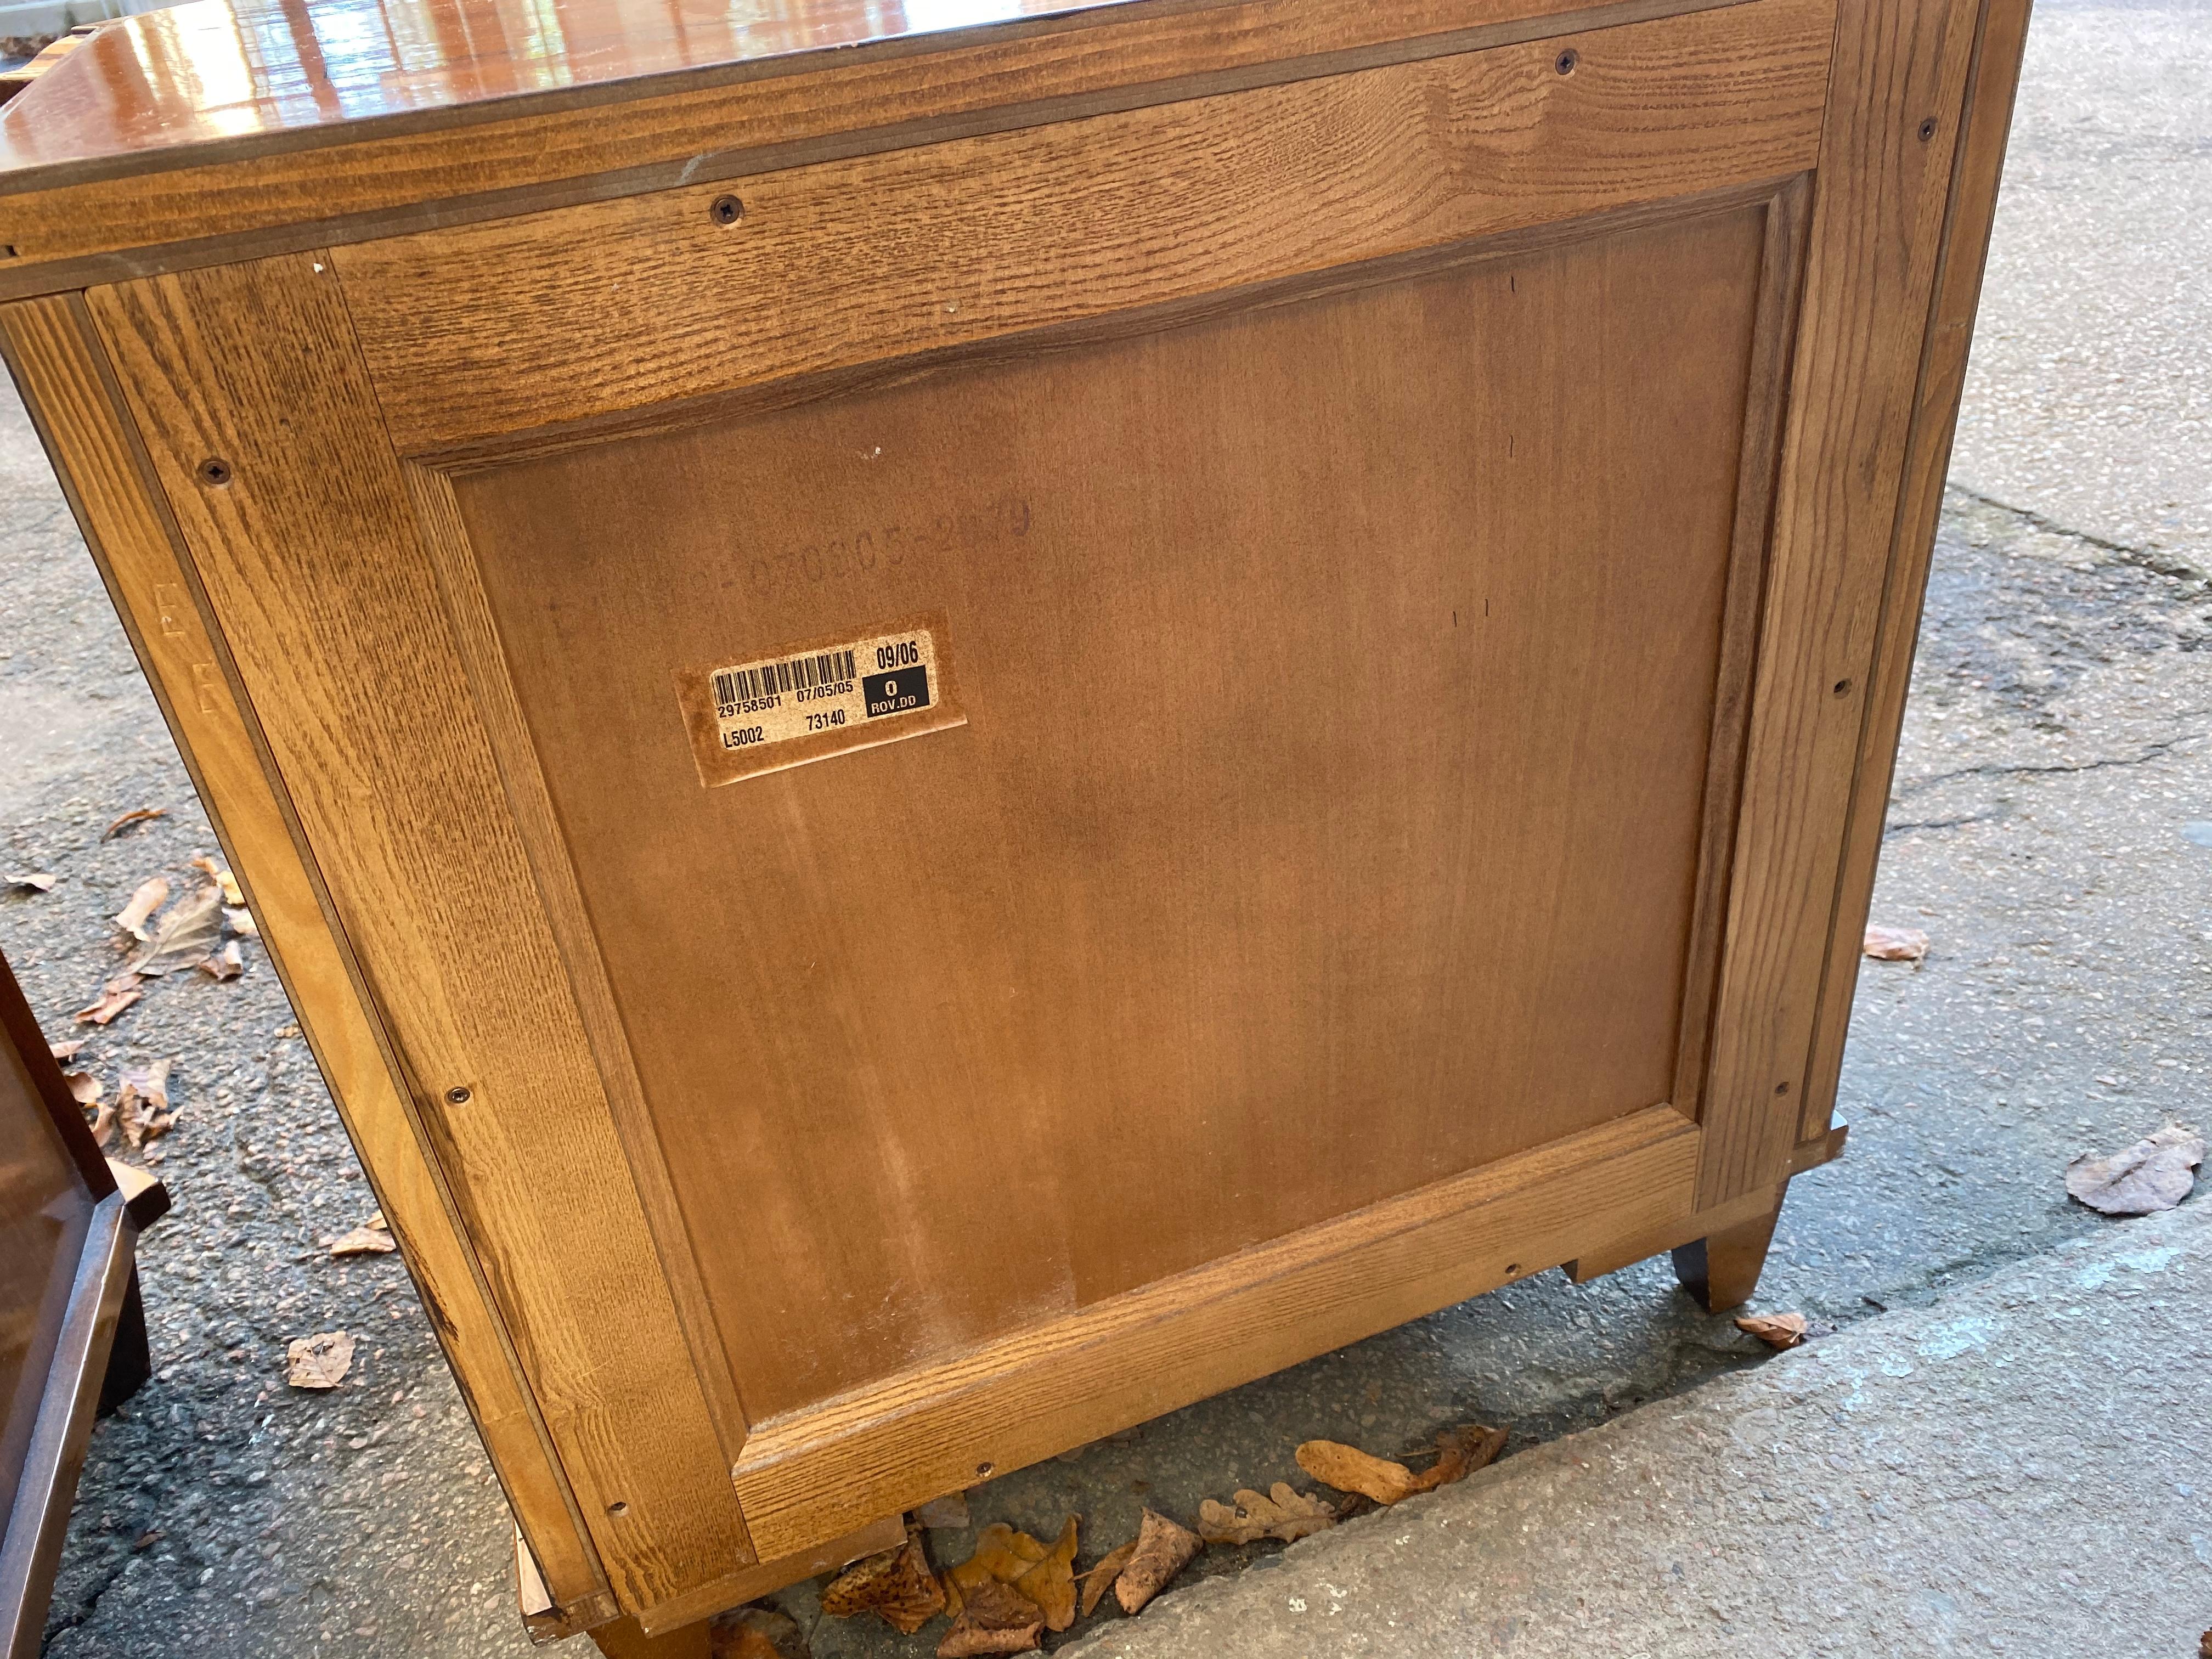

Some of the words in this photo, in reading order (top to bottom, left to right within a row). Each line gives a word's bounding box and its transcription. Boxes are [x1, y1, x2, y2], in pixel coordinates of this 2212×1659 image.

[876, 640, 918, 670] 09/06
[718, 696, 782, 718] 29758501
[797, 681, 854, 701] 07/05/05
[871, 696, 916, 714] ROV.DD
[723, 726, 764, 748] L5002
[805, 709, 845, 731] 73140
